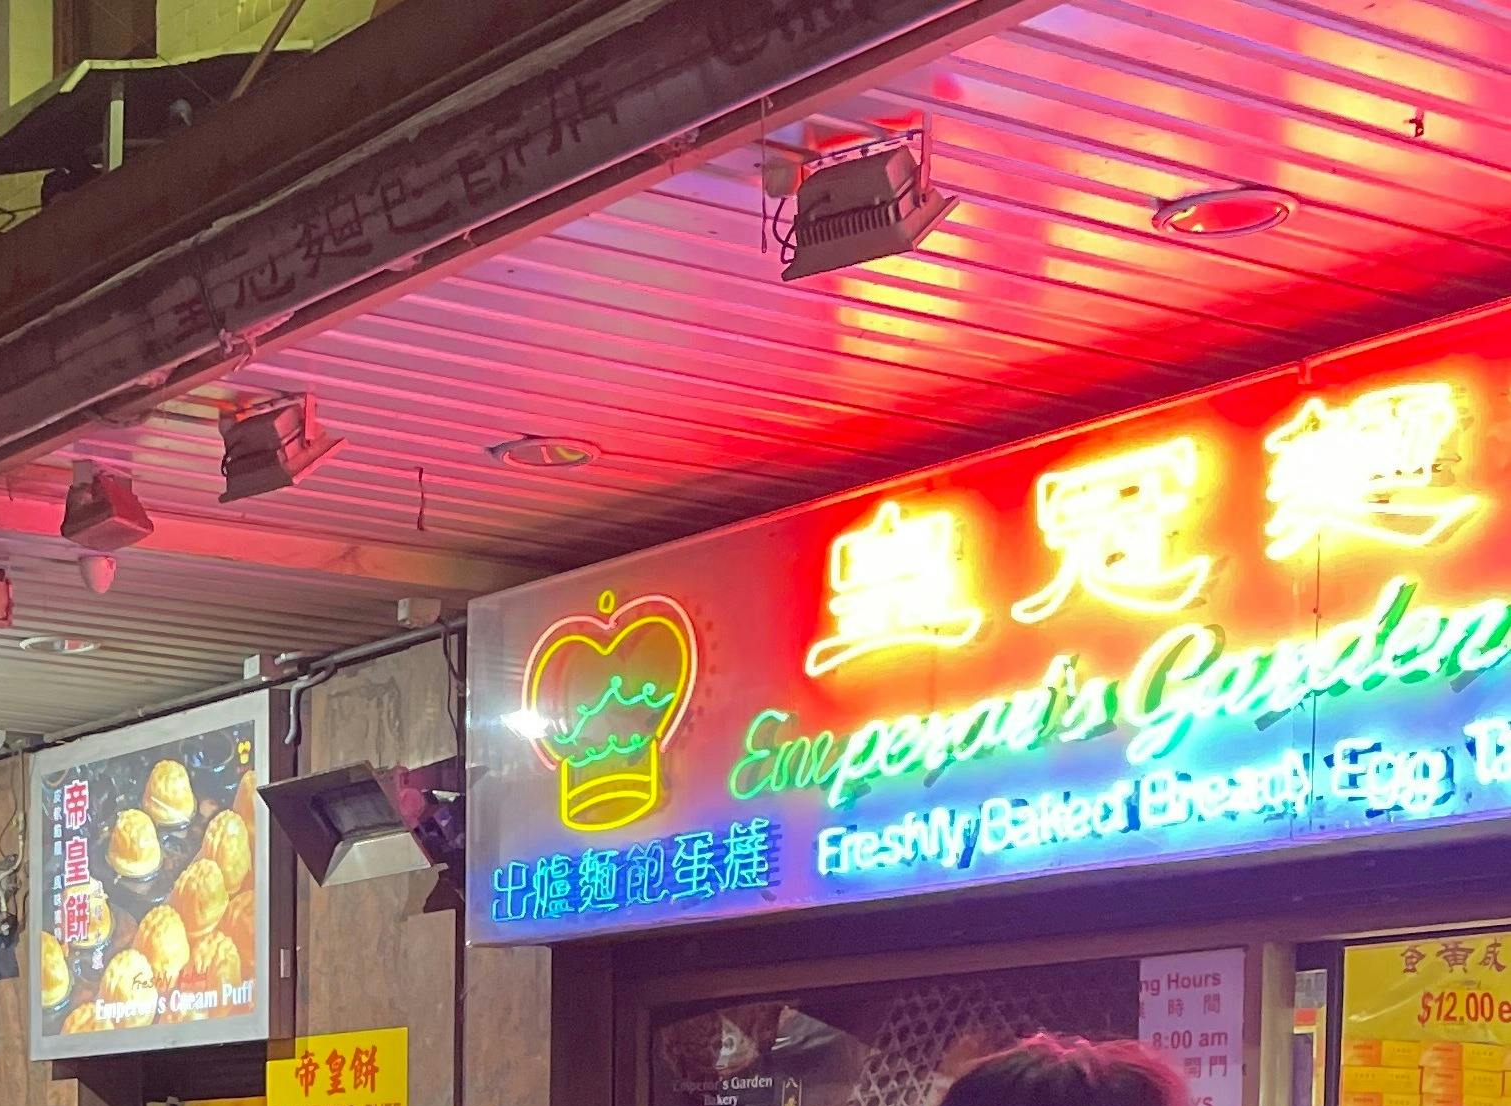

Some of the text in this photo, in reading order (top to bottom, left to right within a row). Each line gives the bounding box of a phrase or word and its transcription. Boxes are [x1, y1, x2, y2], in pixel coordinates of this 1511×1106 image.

[730, 577, 1511, 808] Emperor's Garden
[817, 806, 969, 876] Freshly
[980, 780, 1131, 853] Baked
[1332, 738, 1450, 813] Egg
[64, 779, 90, 943] 帝皇餅
[170, 989, 218, 1012] Cream
[222, 979, 256, 1006] Puff
[1139, 972, 1221, 996] ng Hours
[1417, 991, 1511, 1025] $12.00 e
[1152, 1030, 1228, 1050] 8:00 am
[295, 1044, 380, 1097] 帝皇餅
[730, 1075, 774, 1090] Garden
